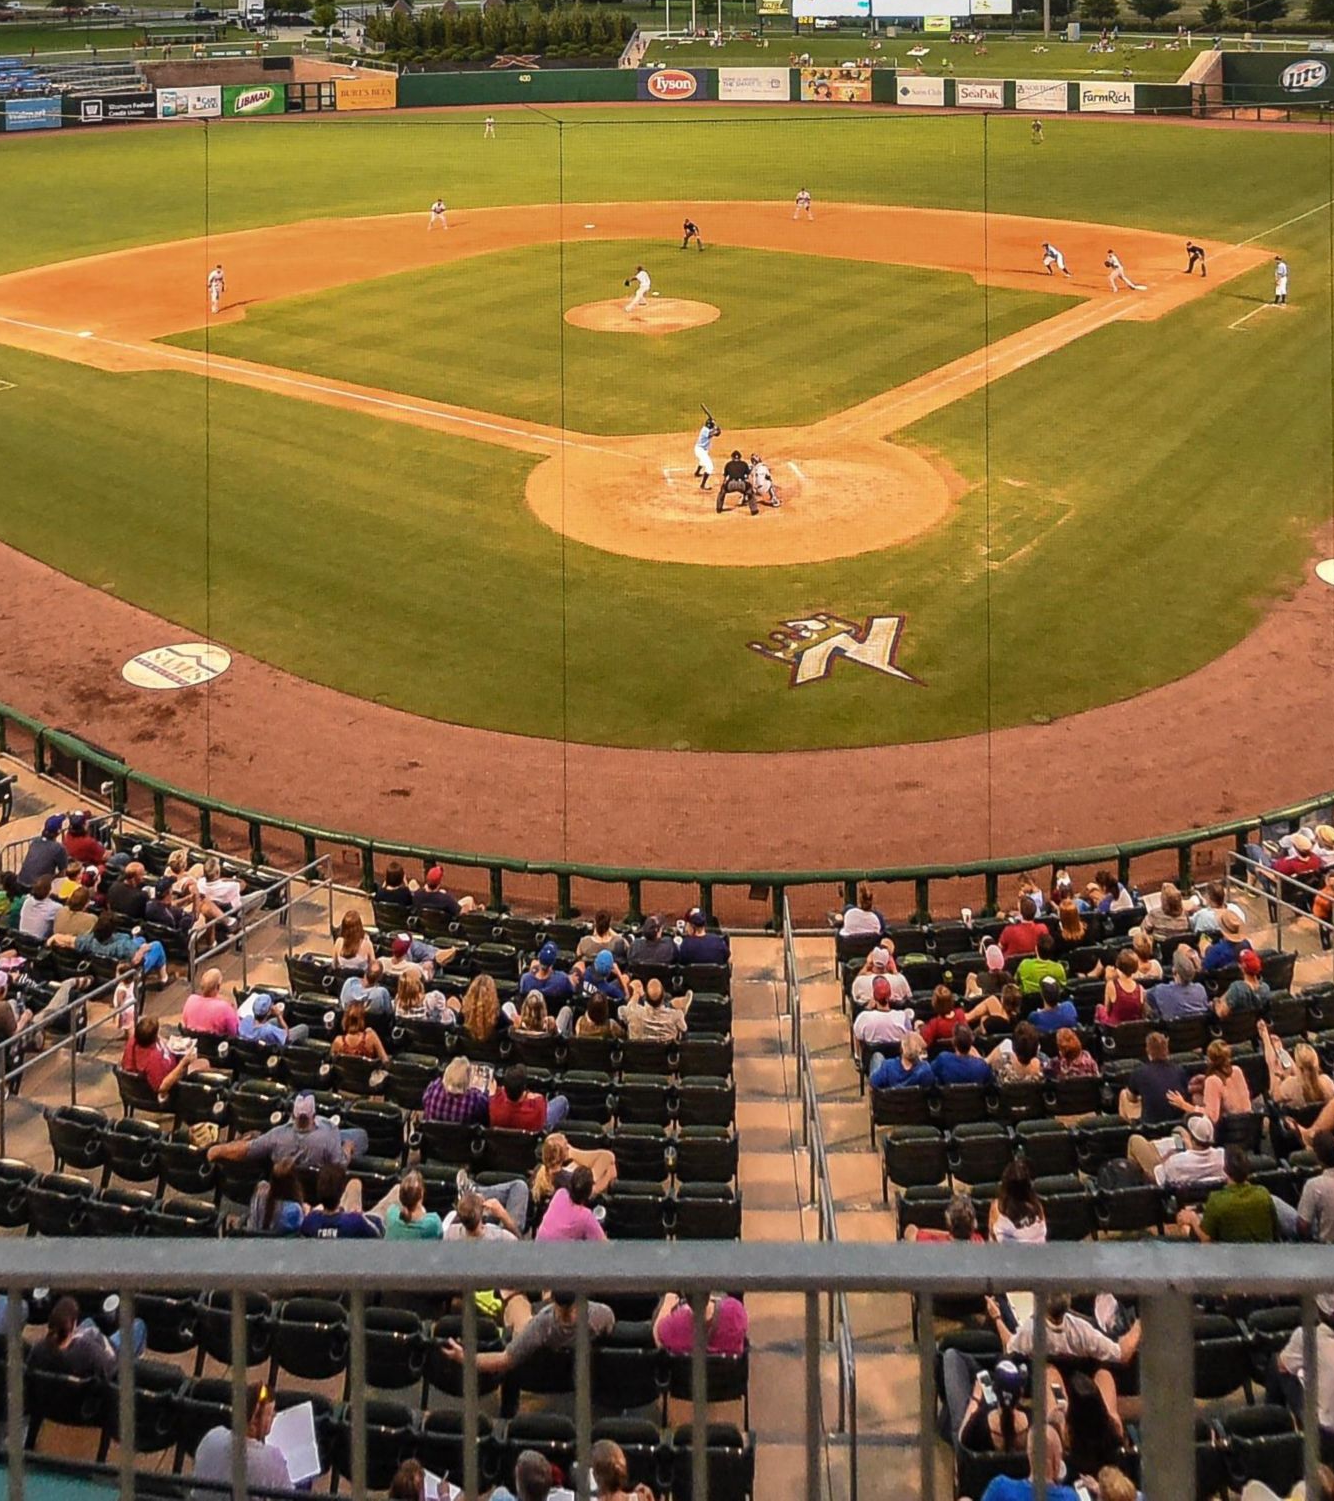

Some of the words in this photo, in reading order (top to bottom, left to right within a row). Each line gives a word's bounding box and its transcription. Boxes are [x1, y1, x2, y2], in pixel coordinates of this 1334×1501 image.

[655, 76, 691, 91] Tyson
[1287, 64, 1323, 86] Lite
[236, 90, 271, 110] LIBMAN
[960, 88, 999, 99] SeaPak
